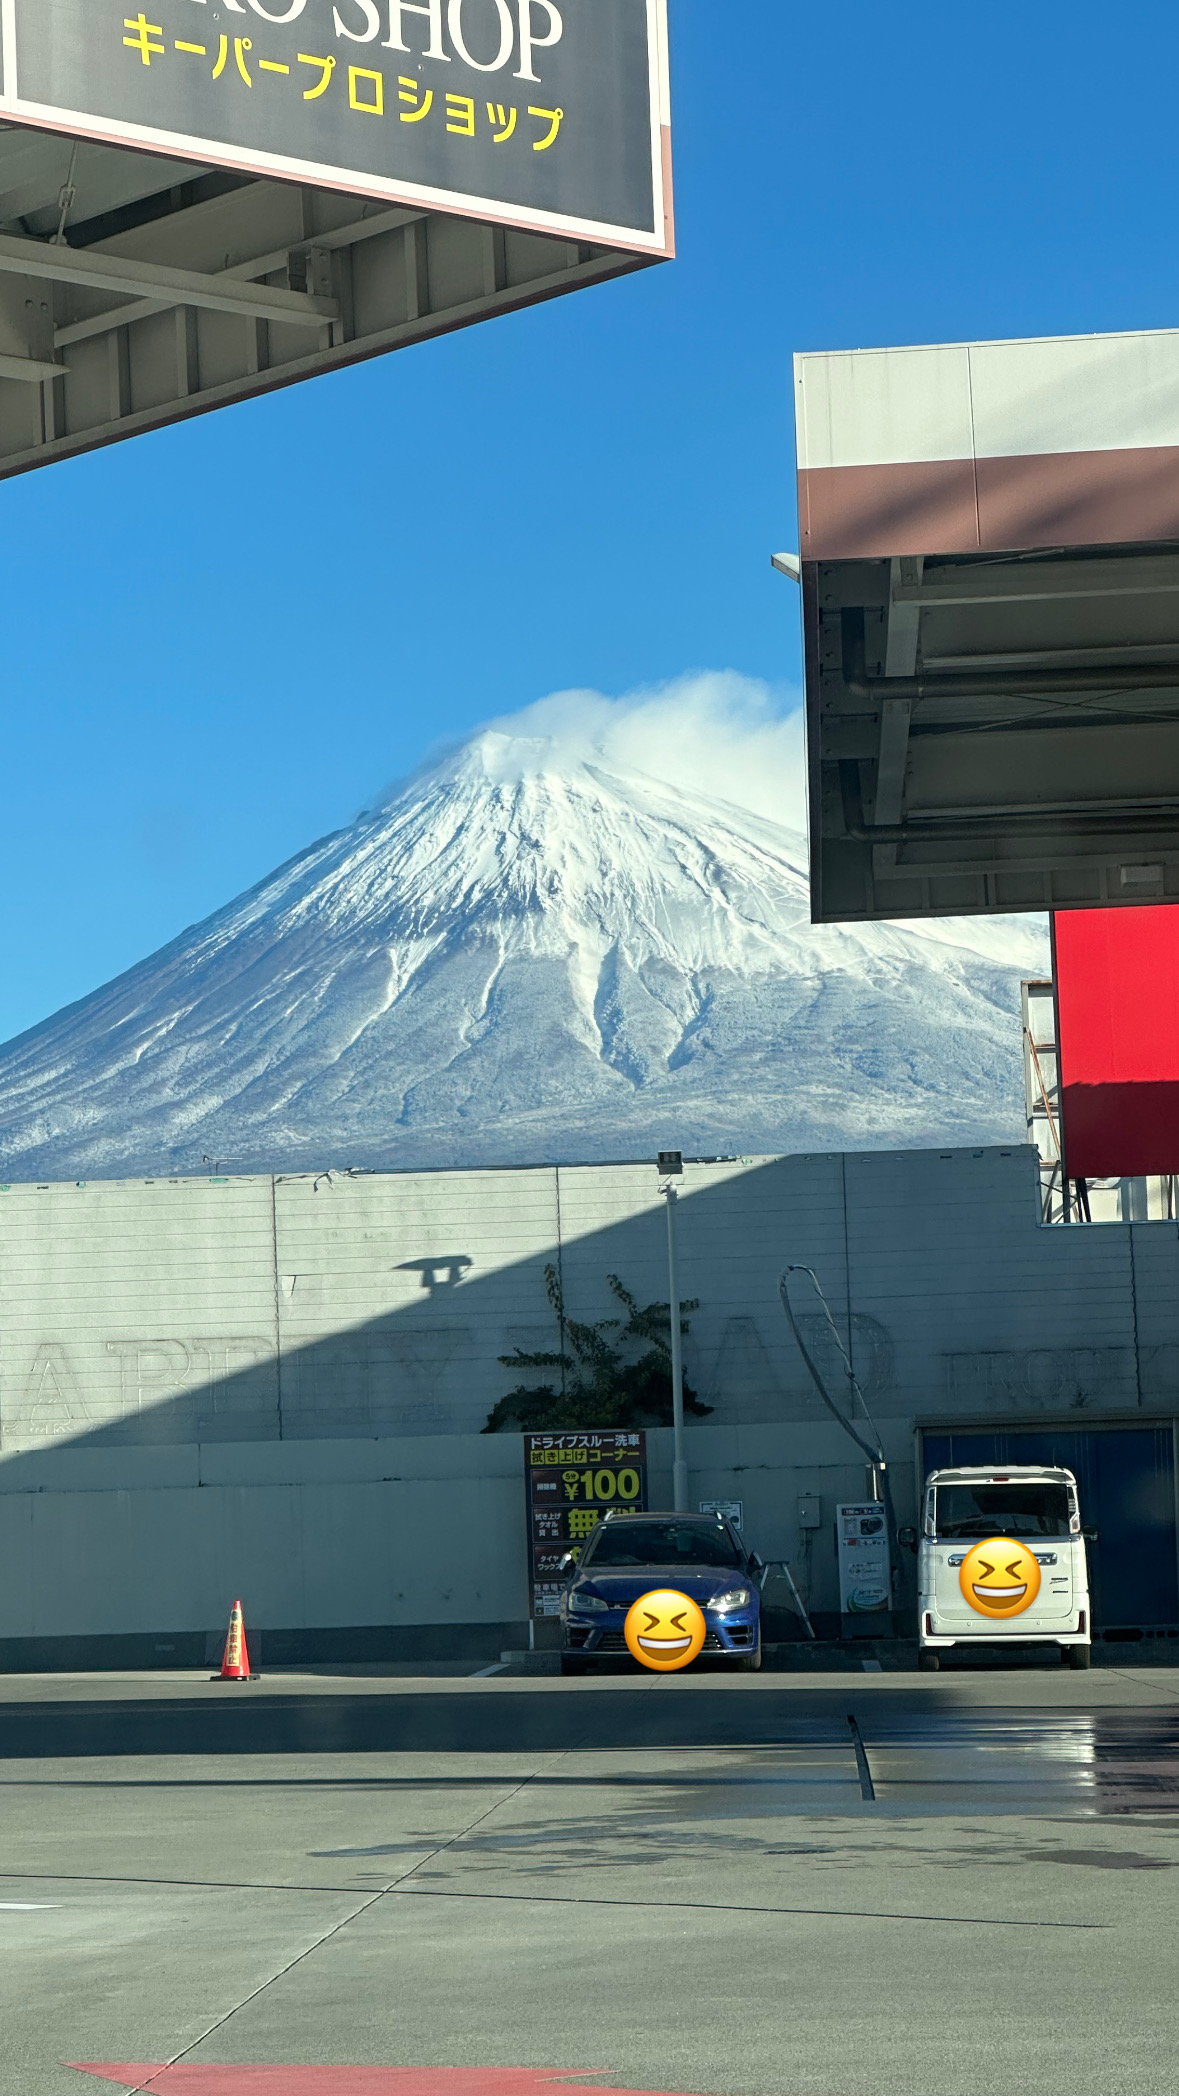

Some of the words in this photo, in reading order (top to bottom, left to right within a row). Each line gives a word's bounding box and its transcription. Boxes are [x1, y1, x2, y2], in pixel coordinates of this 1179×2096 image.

[122, 13, 563, 151] キーパープロショップ
[531, 1434, 640, 1449] ドライブスルー洗車
[530, 1448, 640, 1465] 拭き上げコーナー
[540, 1555, 559, 1563] タイヤ
